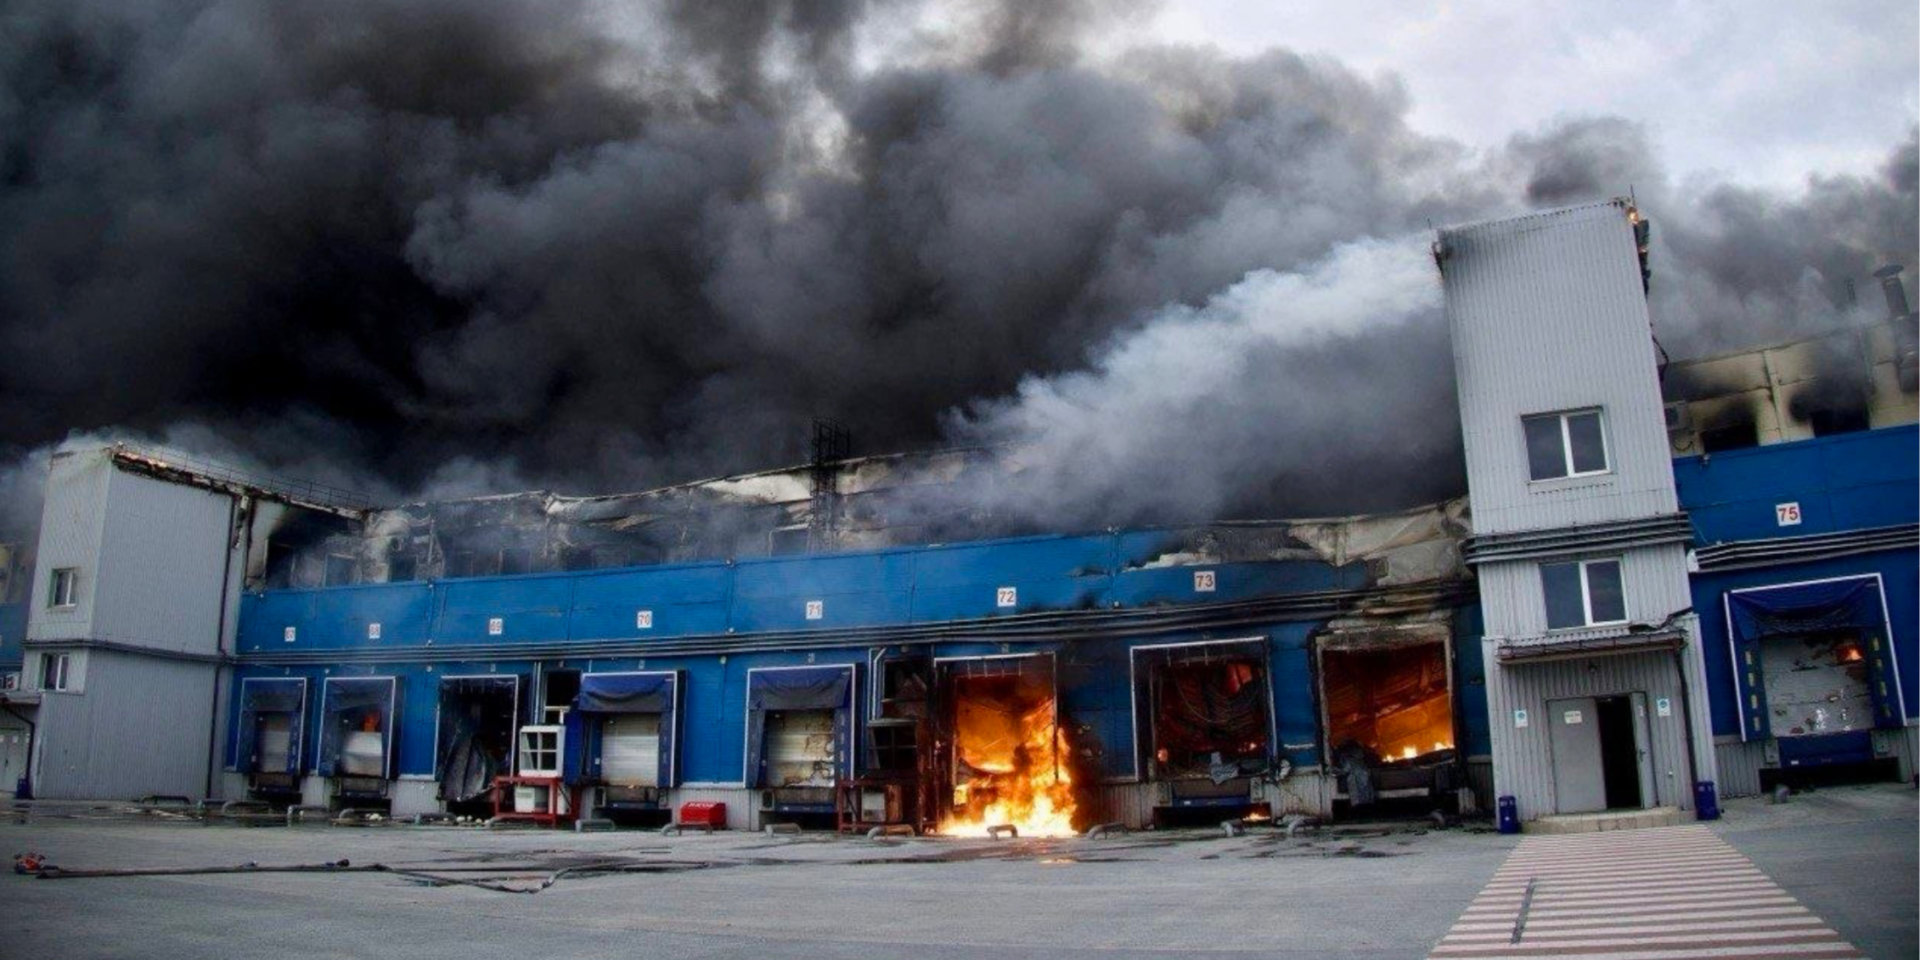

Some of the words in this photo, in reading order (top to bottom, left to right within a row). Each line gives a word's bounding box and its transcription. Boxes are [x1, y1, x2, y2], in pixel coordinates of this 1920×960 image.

[1778, 506, 1799, 522] 75
[1196, 574, 1214, 588] 73
[999, 590, 1014, 603] 72
[808, 603, 822, 616] 71
[638, 613, 651, 626] 70
